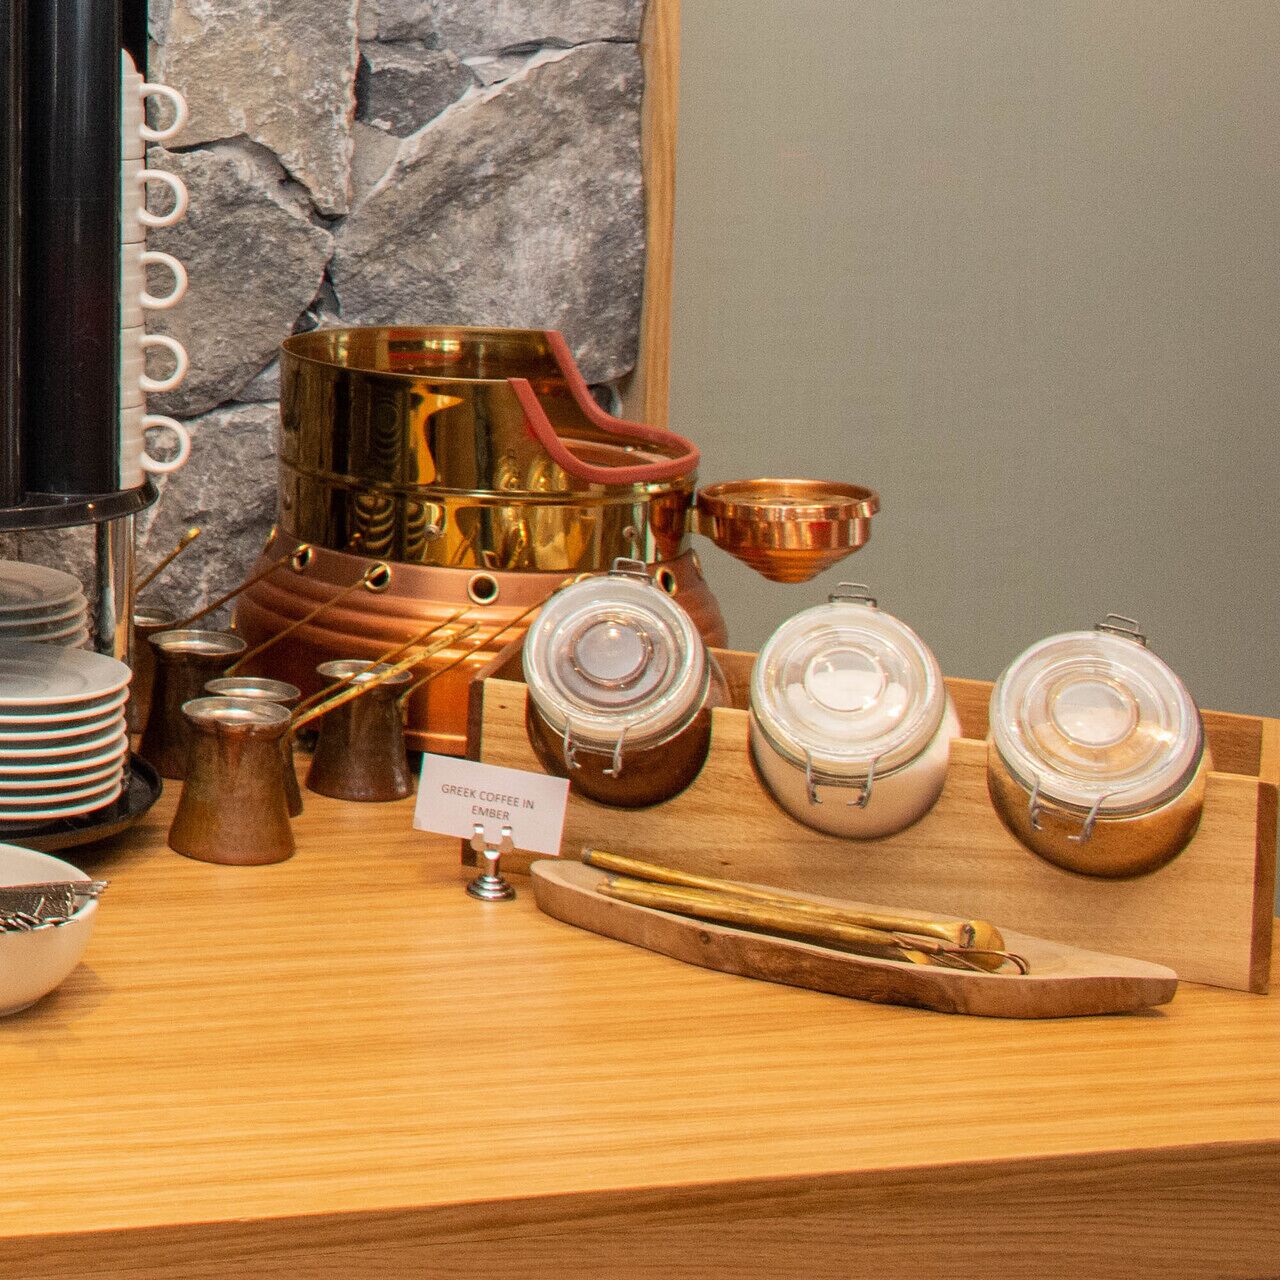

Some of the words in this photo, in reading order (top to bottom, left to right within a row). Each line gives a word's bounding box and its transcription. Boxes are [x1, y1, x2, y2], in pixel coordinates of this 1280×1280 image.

[441, 783, 477, 799] GREEK
[478, 789, 520, 807] COFFEE
[522, 798, 535, 809] IN
[471, 804, 510, 820] EMBER
